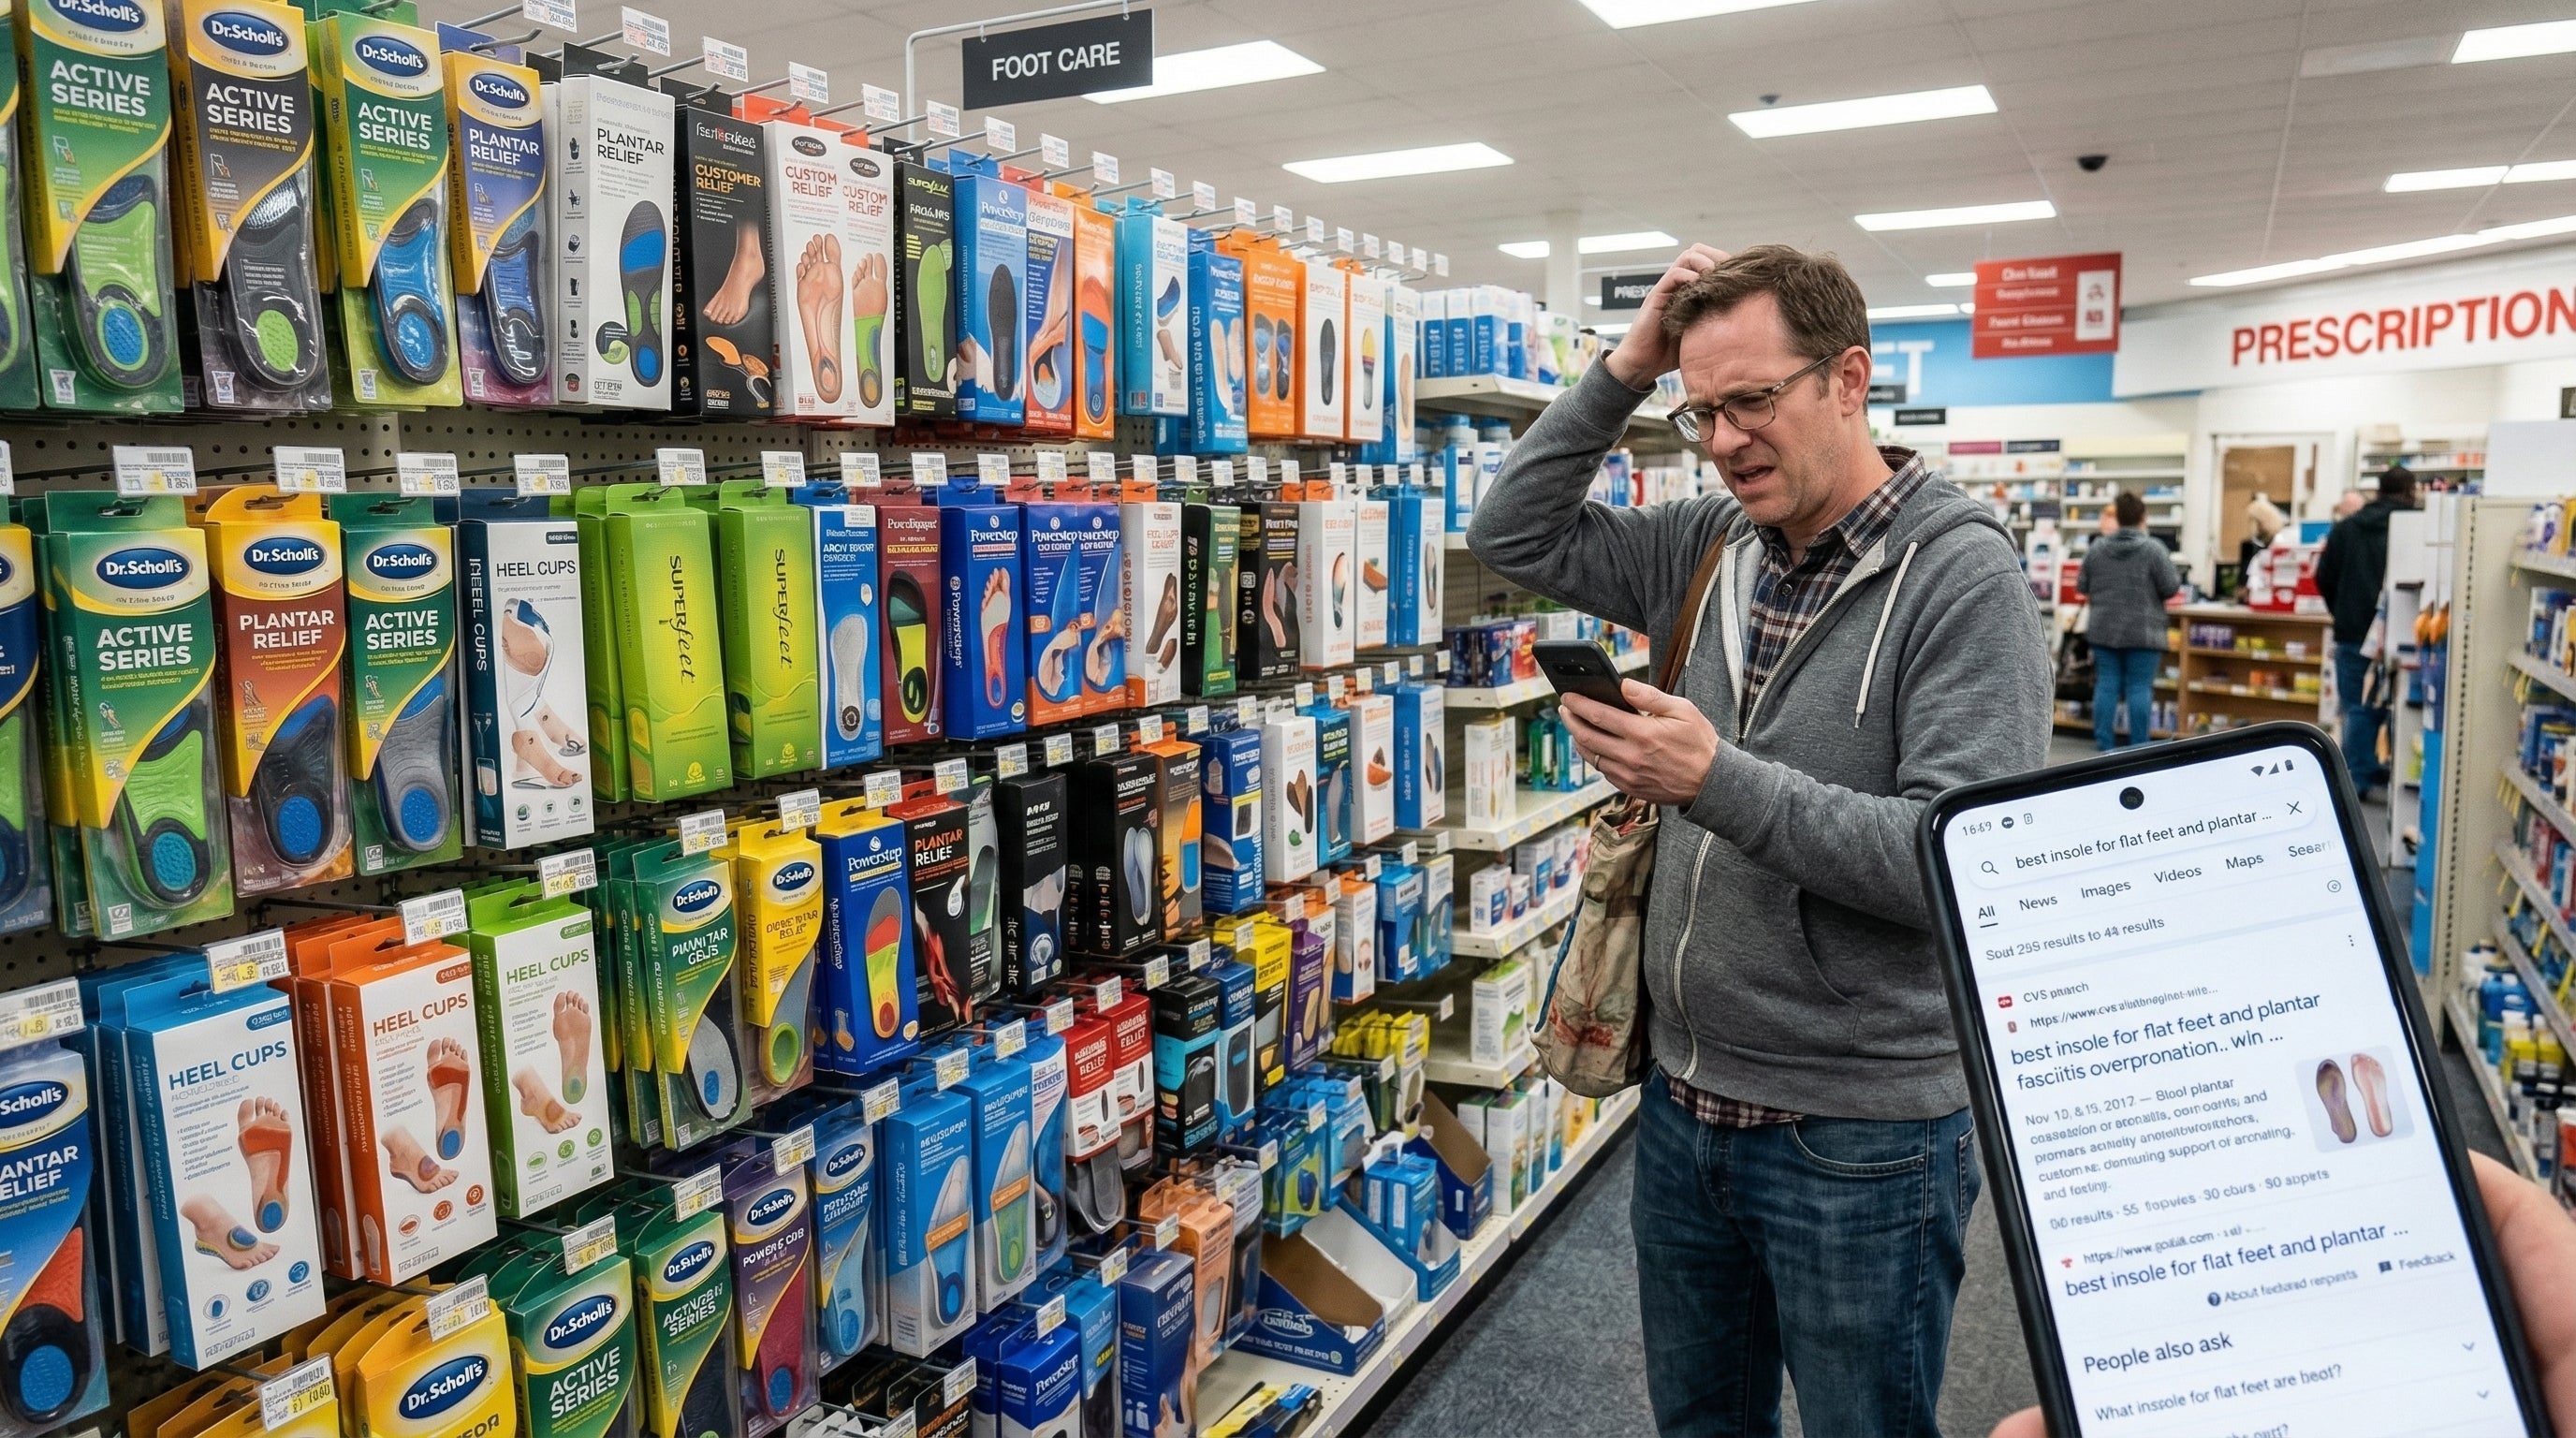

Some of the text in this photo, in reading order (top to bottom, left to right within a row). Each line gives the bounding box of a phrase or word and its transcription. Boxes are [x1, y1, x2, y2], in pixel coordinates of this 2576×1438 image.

[212, 20, 284, 47] Dr.Scholl's
[362, 44, 424, 68] Dr.Scholl's
[992, 41, 1120, 81] FOOT CARE
[51, 60, 151, 95] ACTIVE
[51, 83, 146, 116] SERIES
[206, 83, 295, 114] ACTIVE
[207, 105, 292, 134] SERIES
[358, 102, 432, 131] ACTIVE
[359, 123, 430, 149] SERIES
[470, 128, 540, 155] PLANTAR
[597, 127, 665, 155] PLANTAR
[471, 145, 520, 165] RELIEF
[597, 146, 644, 165] RELIEF
[695, 164, 761, 189] CUSTOMER
[784, 166, 838, 186] CUSTOM
[842, 184, 887, 205] CUSTOM
[106, 559, 183, 577] Dr.Scholl's
[252, 547, 319, 563] Dr.Scholl's
[373, 553, 432, 568] Dr.Scholl's
[496, 560, 577, 577] HEEL CUPS
[240, 610, 335, 631] PLANTAR
[364, 609, 439, 631] ACTIVE
[96, 624, 193, 649] ACTIVE
[253, 629, 323, 649] RELIEF
[366, 629, 438, 650] SERIES
[474, 623, 488, 671] CUPS
[98, 645, 192, 671] SERIES
[2015, 853, 2048, 869] best
[2050, 844, 2093, 862] insole
[2096, 840, 2116, 853] for
[2119, 833, 2144, 848] flat
[2146, 828, 2174, 843] feet
[2178, 820, 2204, 836] and
[2208, 812, 2257, 834] plantar
[1978, 905, 1996, 919] All
[2019, 896, 2058, 911] News
[2081, 881, 2131, 899] Images
[2154, 867, 2203, 883] Videos
[2226, 854, 2264, 870] Maps
[2044, 933, 2086, 949] results
[2088, 931, 2101, 942] to
[2122, 918, 2165, 934] results
[506, 948, 590, 985] HEEL CUPS
[2024, 990, 2048, 1003] CVS
[373, 992, 468, 1036] HEEL CUPS
[2012, 994, 2320, 1064] best insole for flat feet and plantar
[168, 1040, 287, 1091] HEEL CUPS
[2017, 1064, 2086, 1091] fasciitis
[2026, 1114, 2050, 1126] Nov
[2190, 1078, 2234, 1097] plantar
[2244, 1090, 2268, 1105] and
[2168, 1139, 2217, 1159] support
[2066, 1275, 2108, 1297] best
[2112, 1265, 2167, 1288] insole
[2172, 1260, 2198, 1277] for
[2203, 1252, 2233, 1271] flat
[2238, 1244, 2276, 1264] feet
[2280, 1235, 2317, 1255] and
[2320, 1225, 2386, 1253] plantar
[550, 1300, 613, 1342] Dr.Scholl's
[669, 1301, 716, 1337] SERIES
[2084, 1332, 2233, 1374] People also ask
[407, 1360, 483, 1411] Dr.Scholl's
[549, 1346, 621, 1401] ACTIVE
[551, 1369, 620, 1419] SERIES
[2095, 1405, 2134, 1421] What
[2190, 1390, 2210, 1403] for
[2214, 1386, 2238, 1400] flat
[2241, 1379, 2270, 1394] feet
[2274, 1375, 2297, 1388] are
